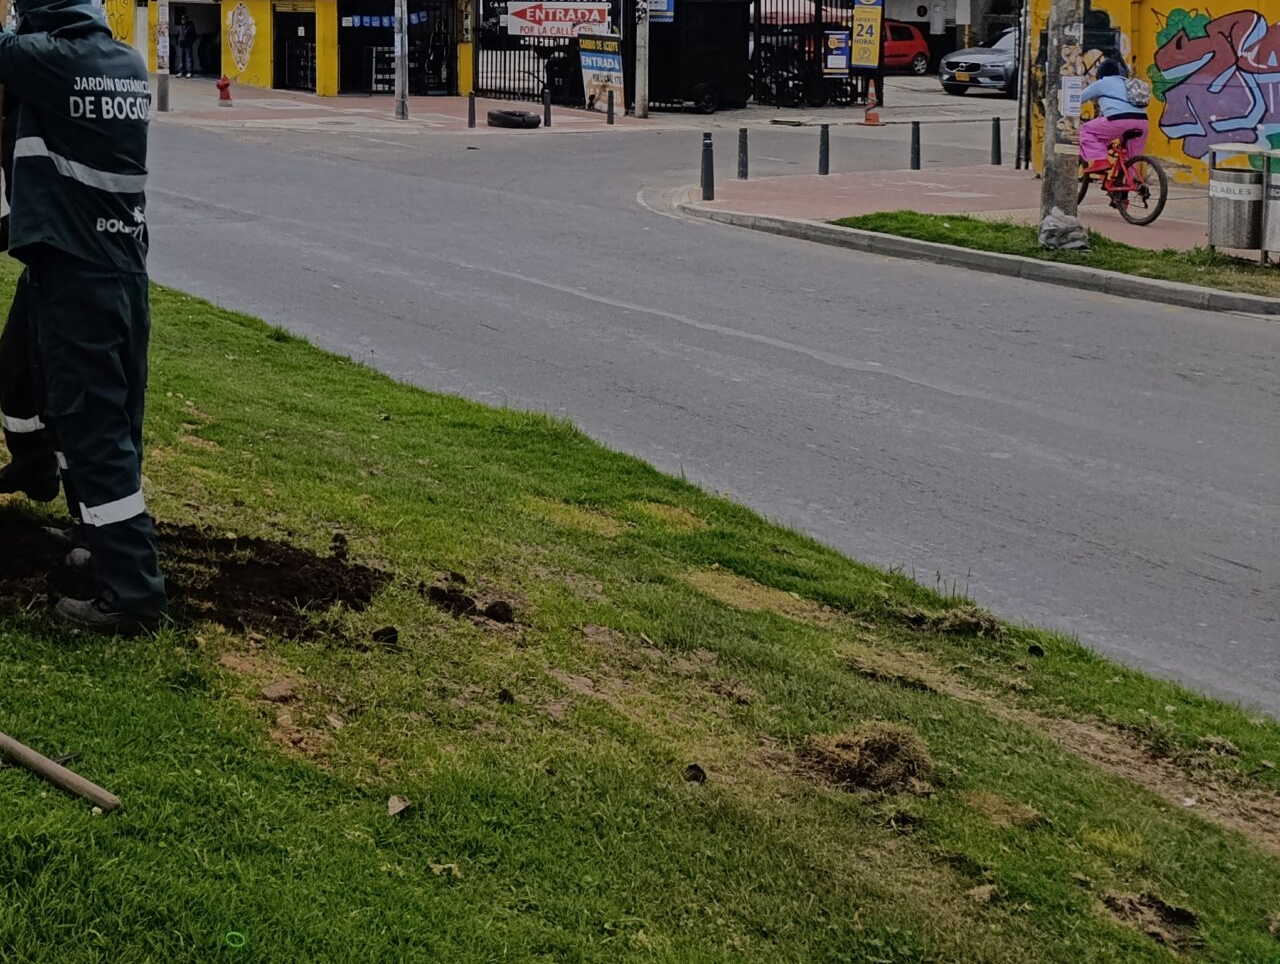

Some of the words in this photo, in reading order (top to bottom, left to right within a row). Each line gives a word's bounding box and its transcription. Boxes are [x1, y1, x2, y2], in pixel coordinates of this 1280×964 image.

[526, 8, 601, 22] ENTRADA
[520, 25, 534, 34] POR
[538, 26, 547, 34] LA
[550, 26, 575, 36] CALLE
[856, 24, 874, 37] 24
[582, 56, 620, 69] ENTRADA
[73, 75, 115, 91] JARDÍN
[70, 96, 97, 118] DE
